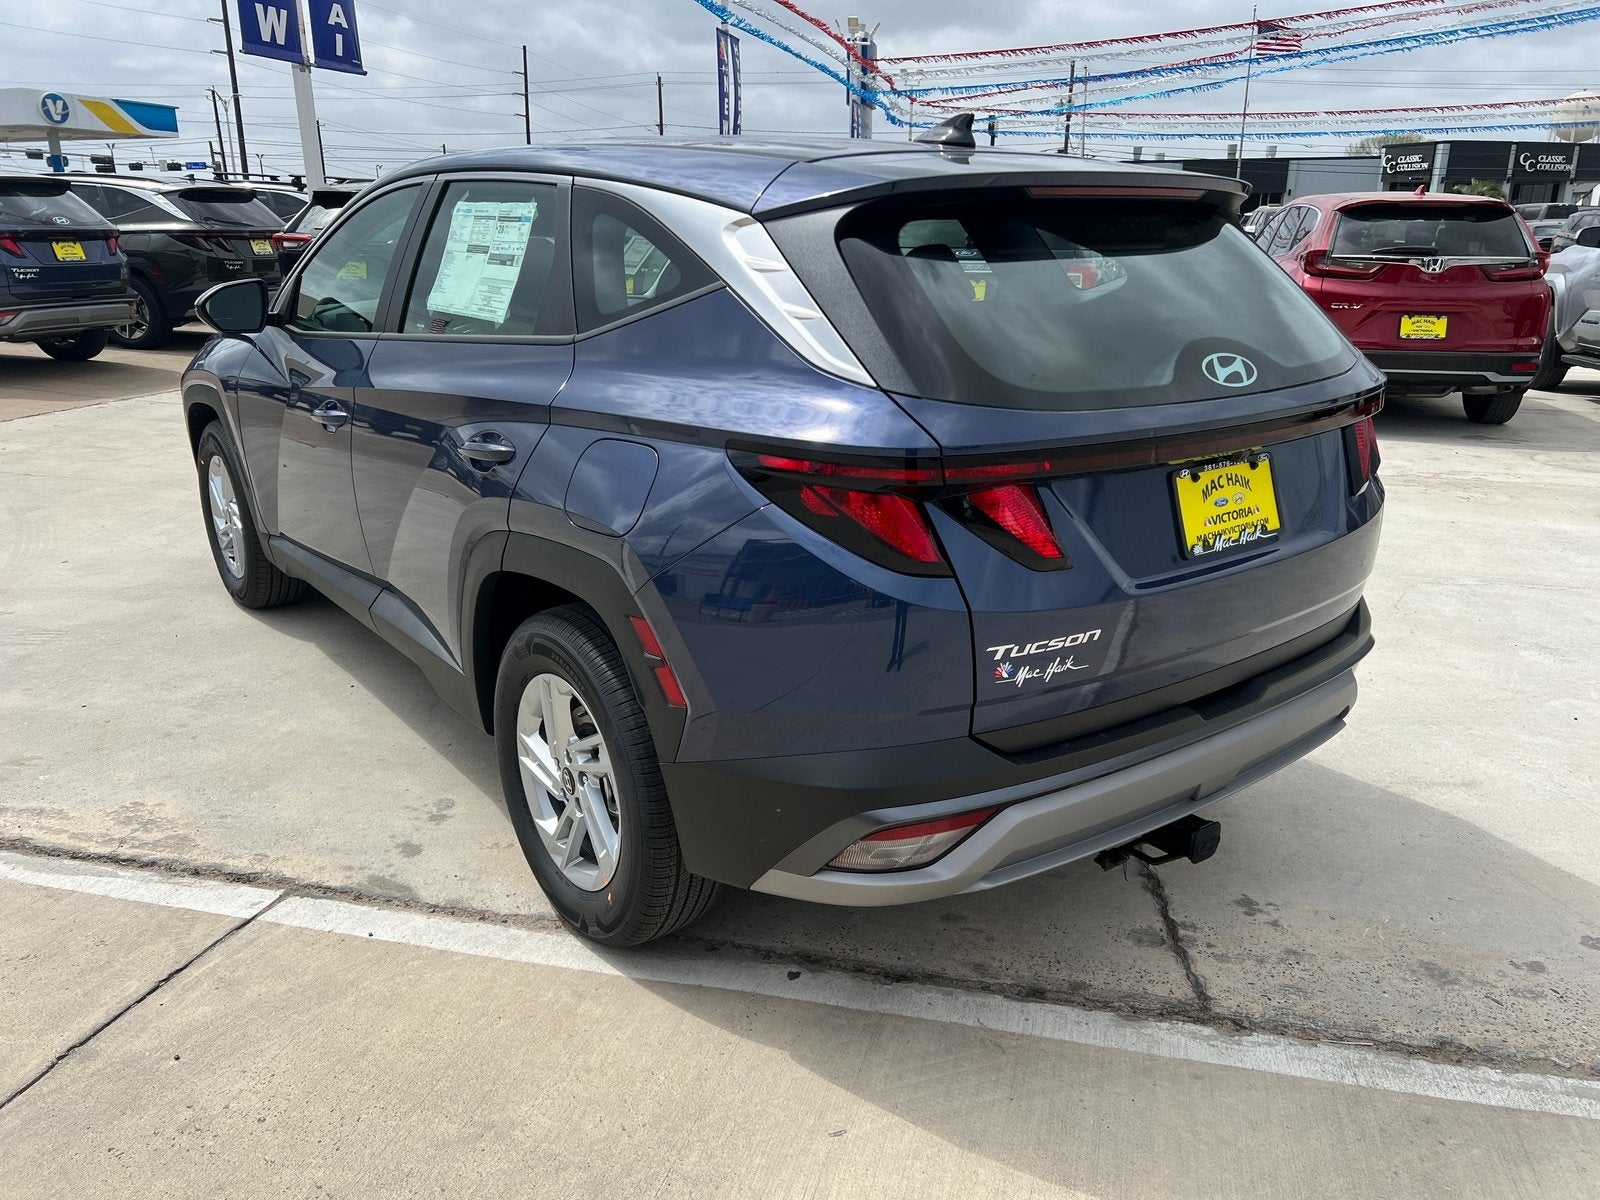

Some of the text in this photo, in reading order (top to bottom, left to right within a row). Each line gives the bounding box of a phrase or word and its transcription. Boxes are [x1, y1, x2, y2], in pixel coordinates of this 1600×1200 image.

[1397, 154, 1423, 163] CLASSIC
[1538, 155, 1566, 163] CLASSIC
[1396, 162, 1429, 172] COLLISION
[1536, 163, 1574, 172] COLLISION
[1201, 472, 1253, 503] MAC HAIK
[1210, 505, 1254, 526] VICTORIA
[1214, 524, 1277, 553] Mac Haik
[1014, 654, 1089, 688] Mac Haik
